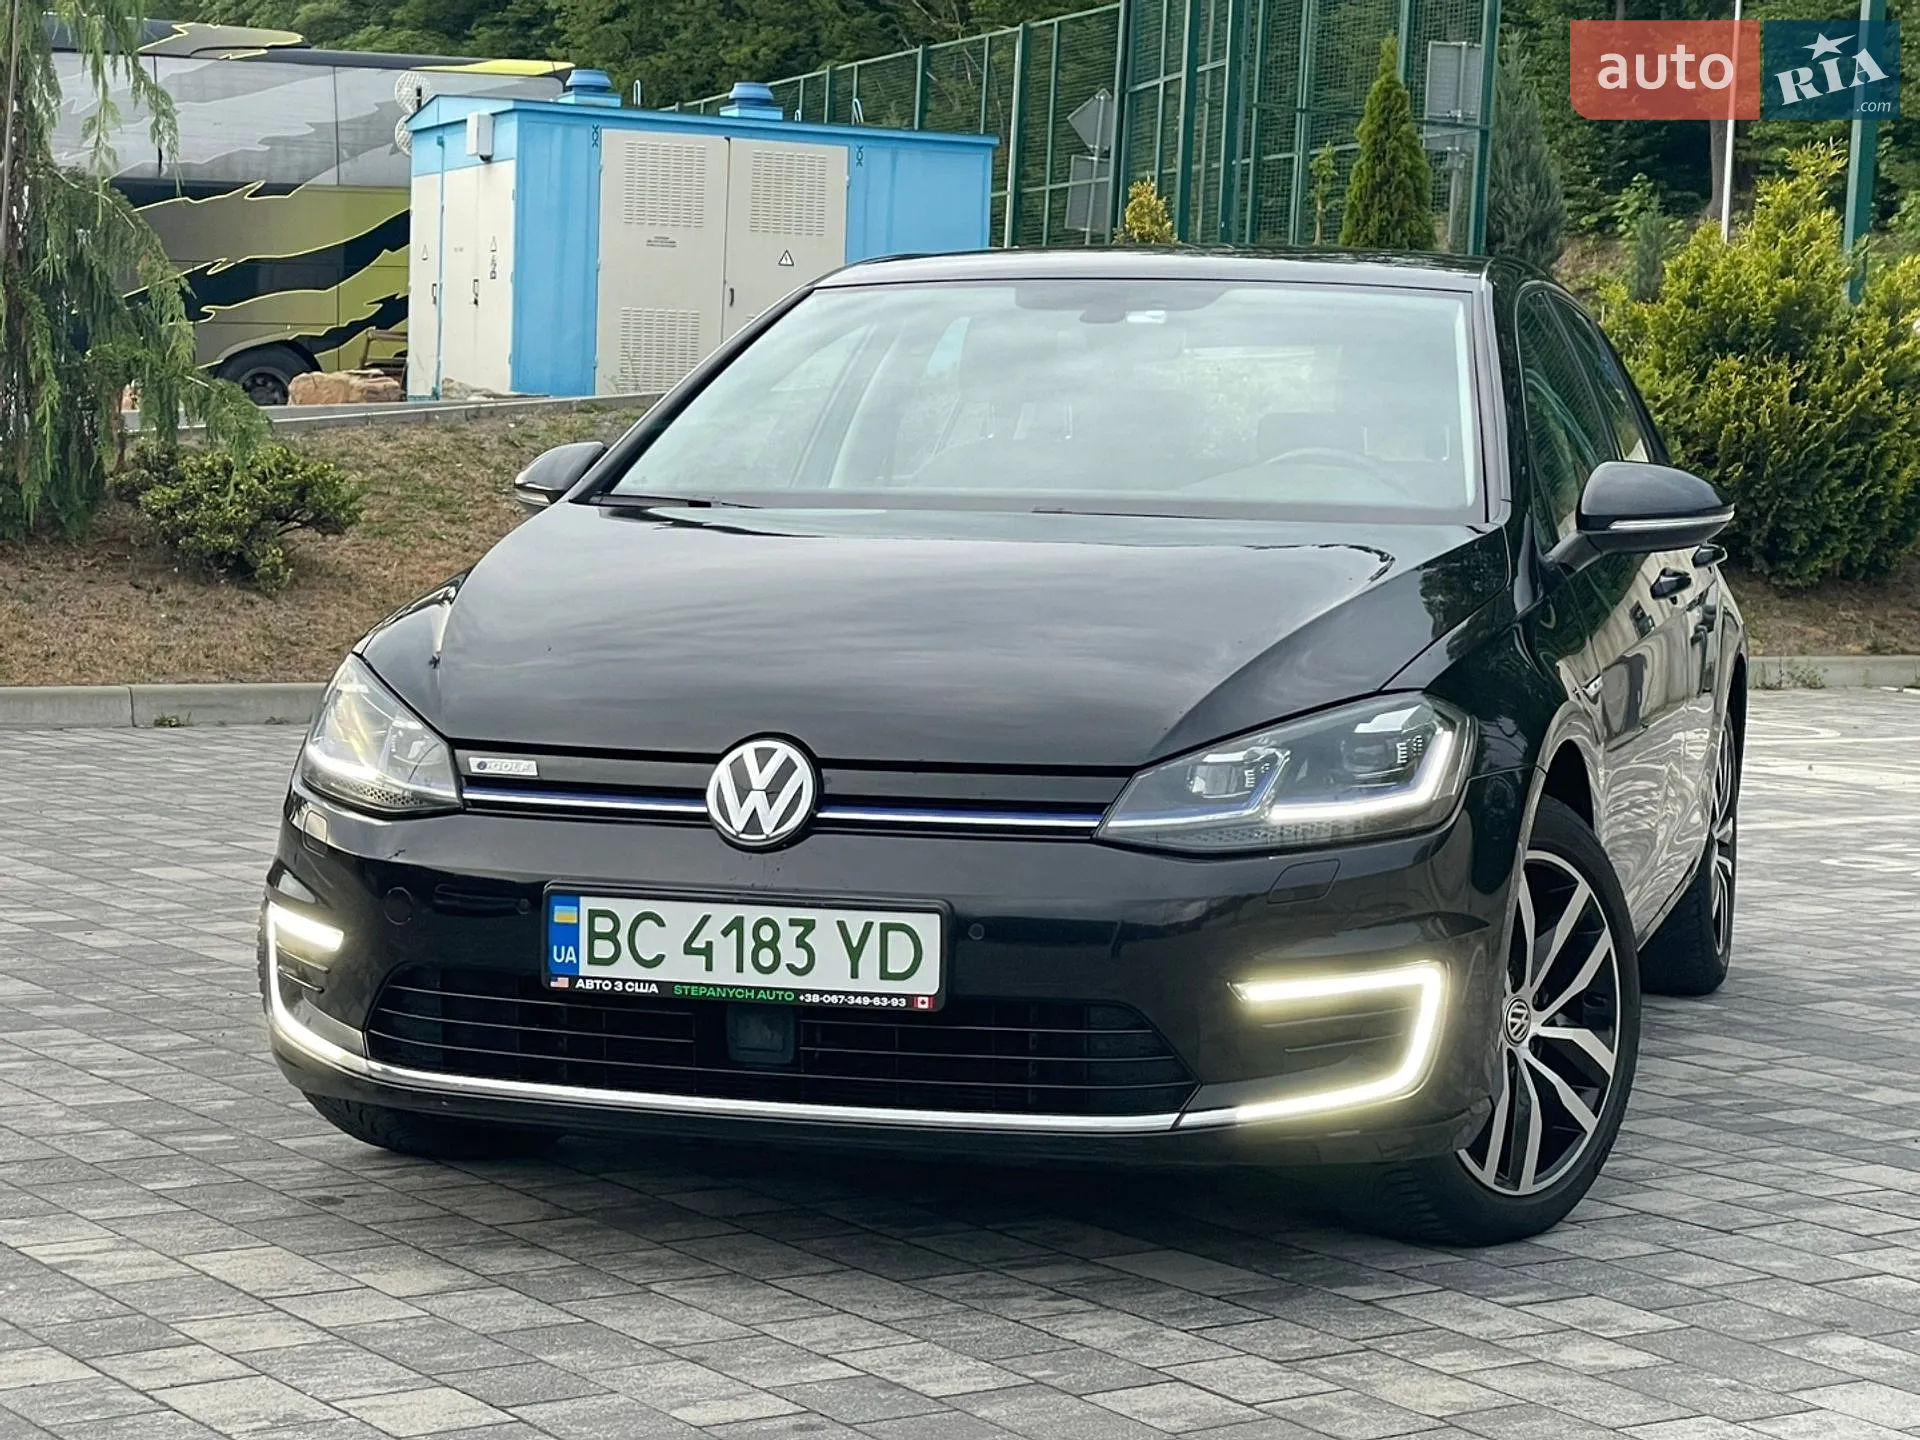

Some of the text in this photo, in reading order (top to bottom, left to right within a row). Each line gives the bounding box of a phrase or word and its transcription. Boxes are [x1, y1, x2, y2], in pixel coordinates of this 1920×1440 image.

[587, 909, 922, 981] BC 4183 YD
[553, 946, 577, 964] UA
[575, 978, 612, 991] АВТО
[626, 981, 659, 994] США
[674, 984, 795, 1001] STEPANYCH AUTO
